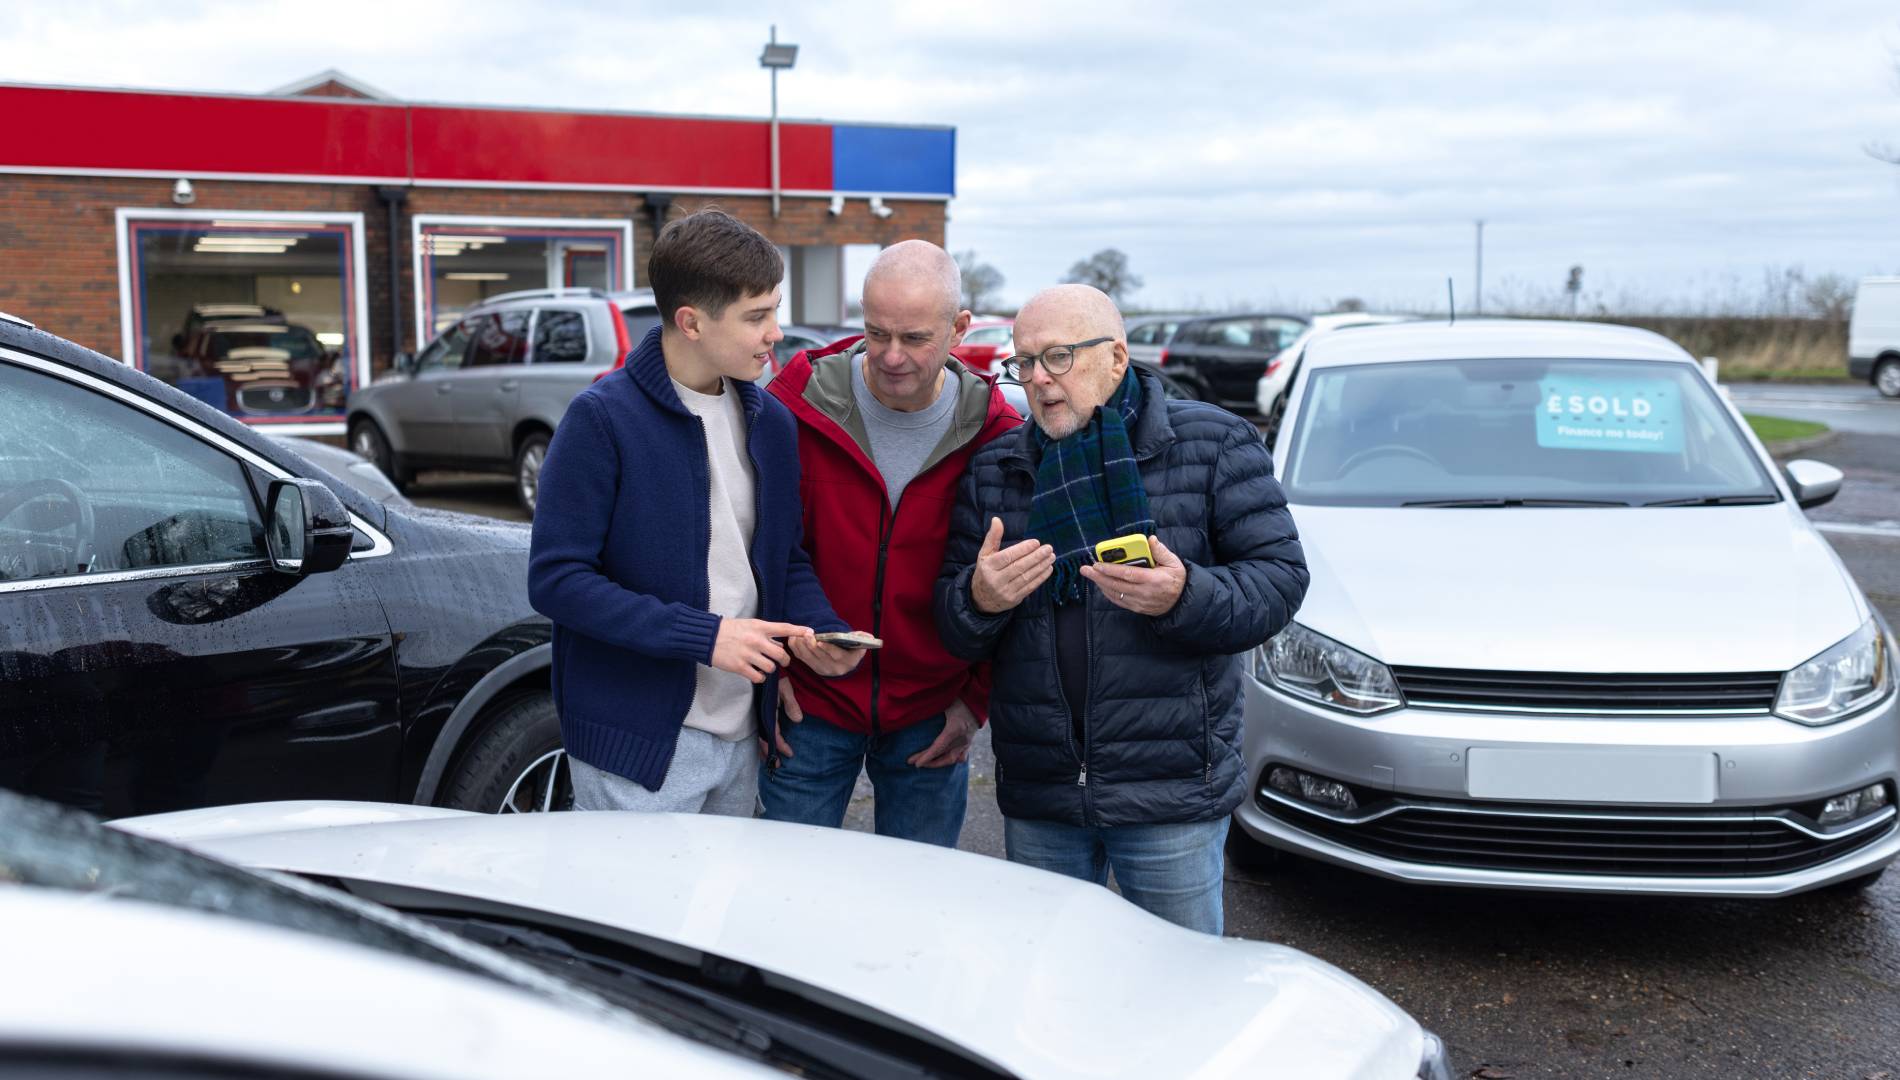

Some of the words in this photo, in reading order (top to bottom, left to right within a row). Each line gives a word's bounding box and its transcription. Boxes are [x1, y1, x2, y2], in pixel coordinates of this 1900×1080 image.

[1557, 425, 1602, 438] Finance
[1605, 430, 1624, 439] me
[1626, 429, 1664, 441] today!
